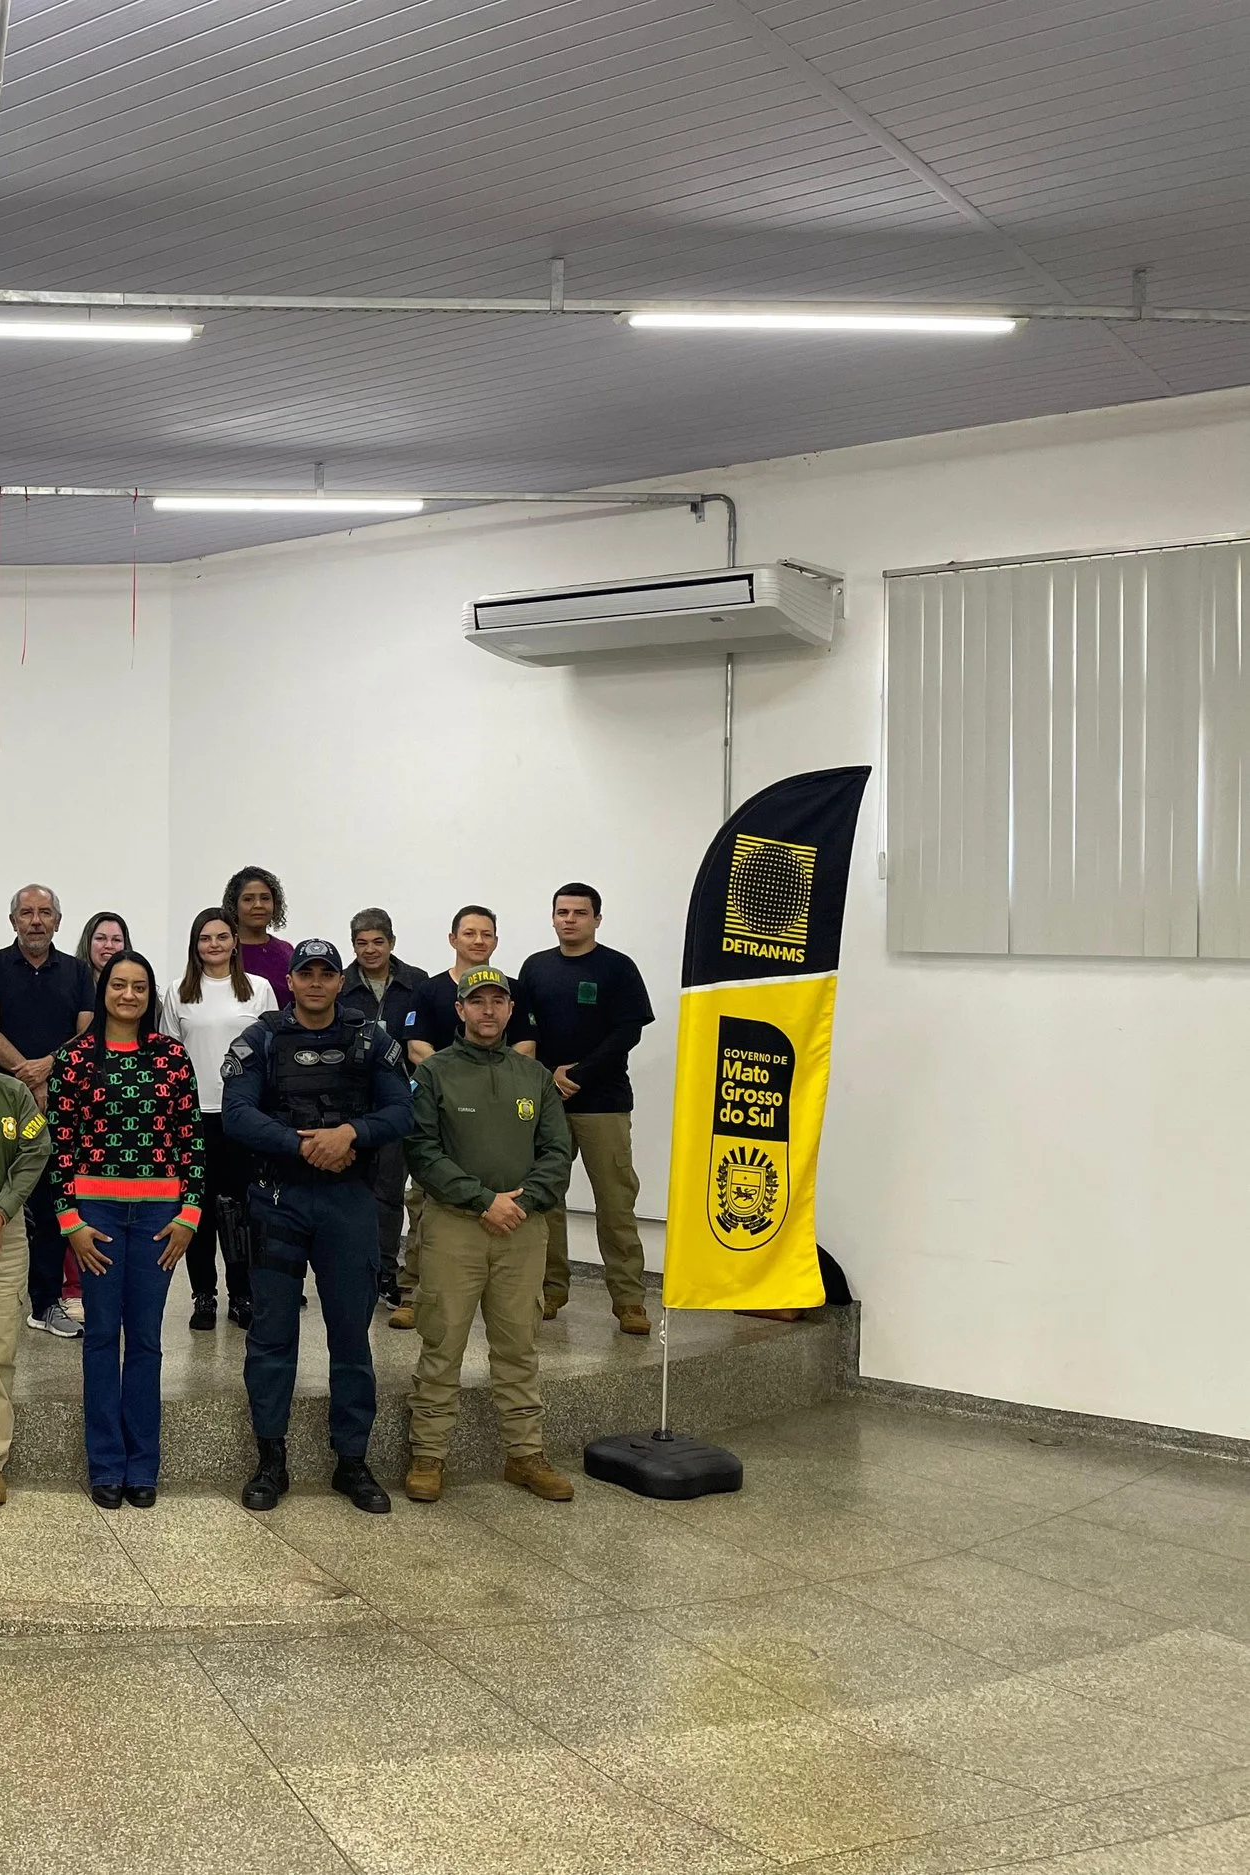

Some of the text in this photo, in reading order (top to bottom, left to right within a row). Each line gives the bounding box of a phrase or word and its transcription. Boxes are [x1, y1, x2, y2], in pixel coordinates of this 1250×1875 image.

[467, 970, 501, 986] DETRAN
[724, 1048, 788, 1065] GOVERNO DE
[722, 1059, 769, 1084] Mato
[721, 1081, 783, 1107] Grosso
[720, 1102, 775, 1127] do Sul
